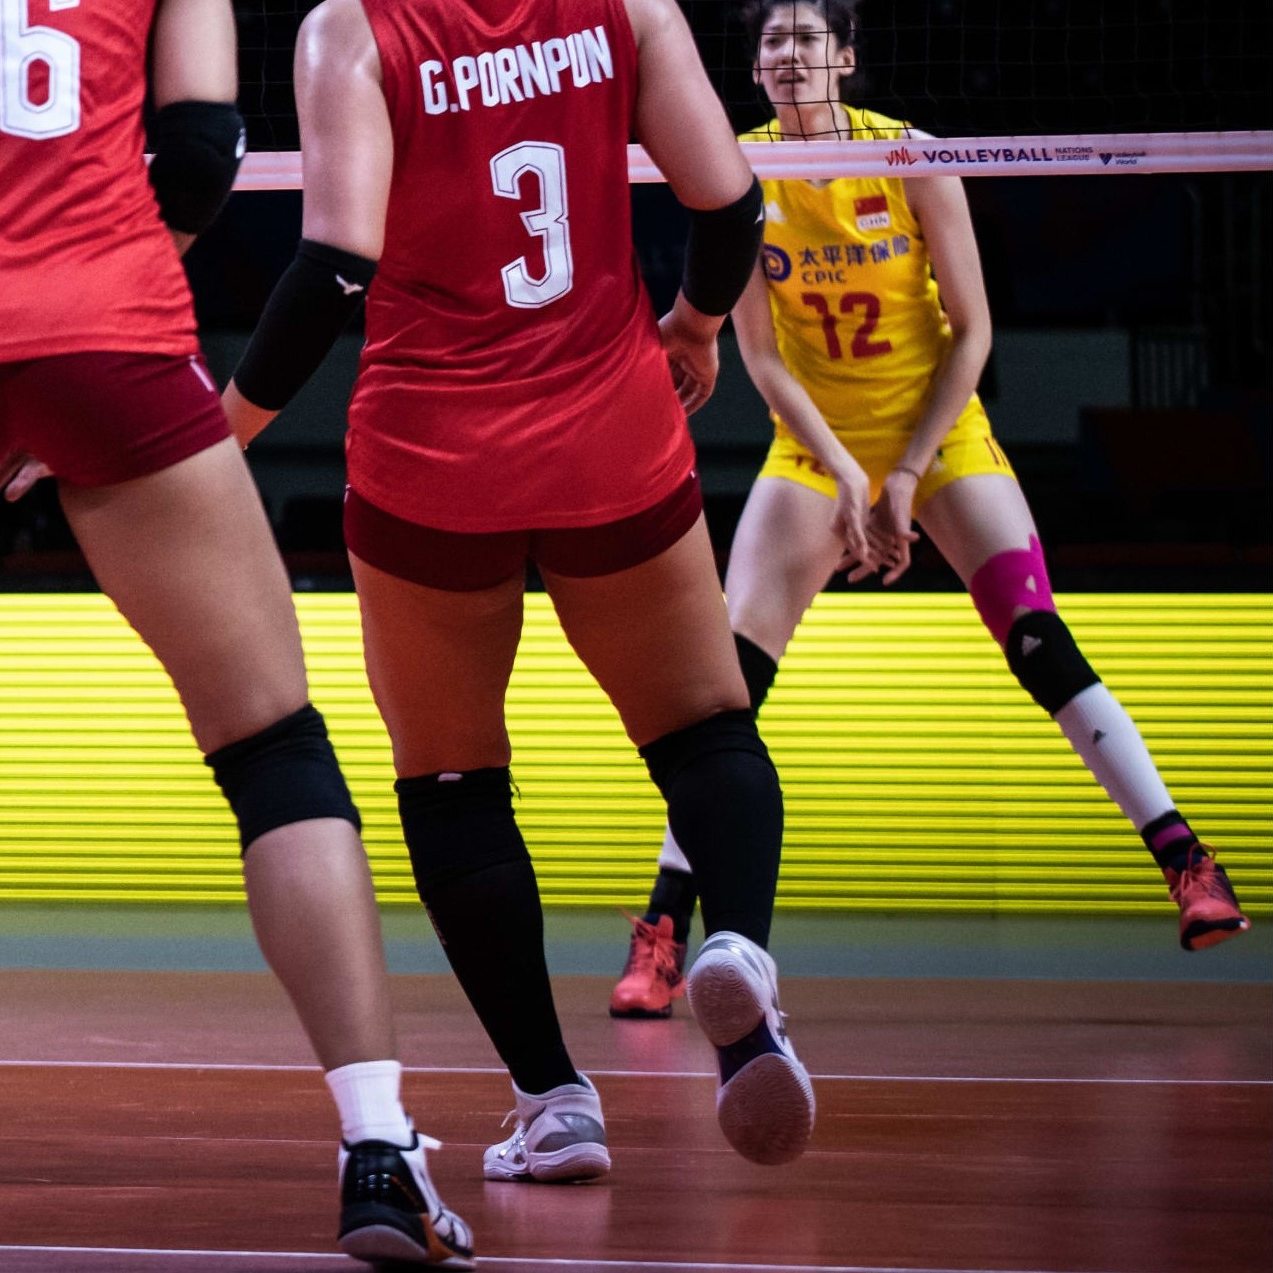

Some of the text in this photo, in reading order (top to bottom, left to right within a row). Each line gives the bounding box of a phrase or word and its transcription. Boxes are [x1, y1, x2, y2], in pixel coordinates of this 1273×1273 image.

[419, 25, 614, 115] G.PORNPUN
[922, 148, 1053, 163] VOLLEYBALL
[1056, 154, 1090, 162] LEAGUE
[489, 140, 574, 309] 3
[801, 291, 892, 360] 12
